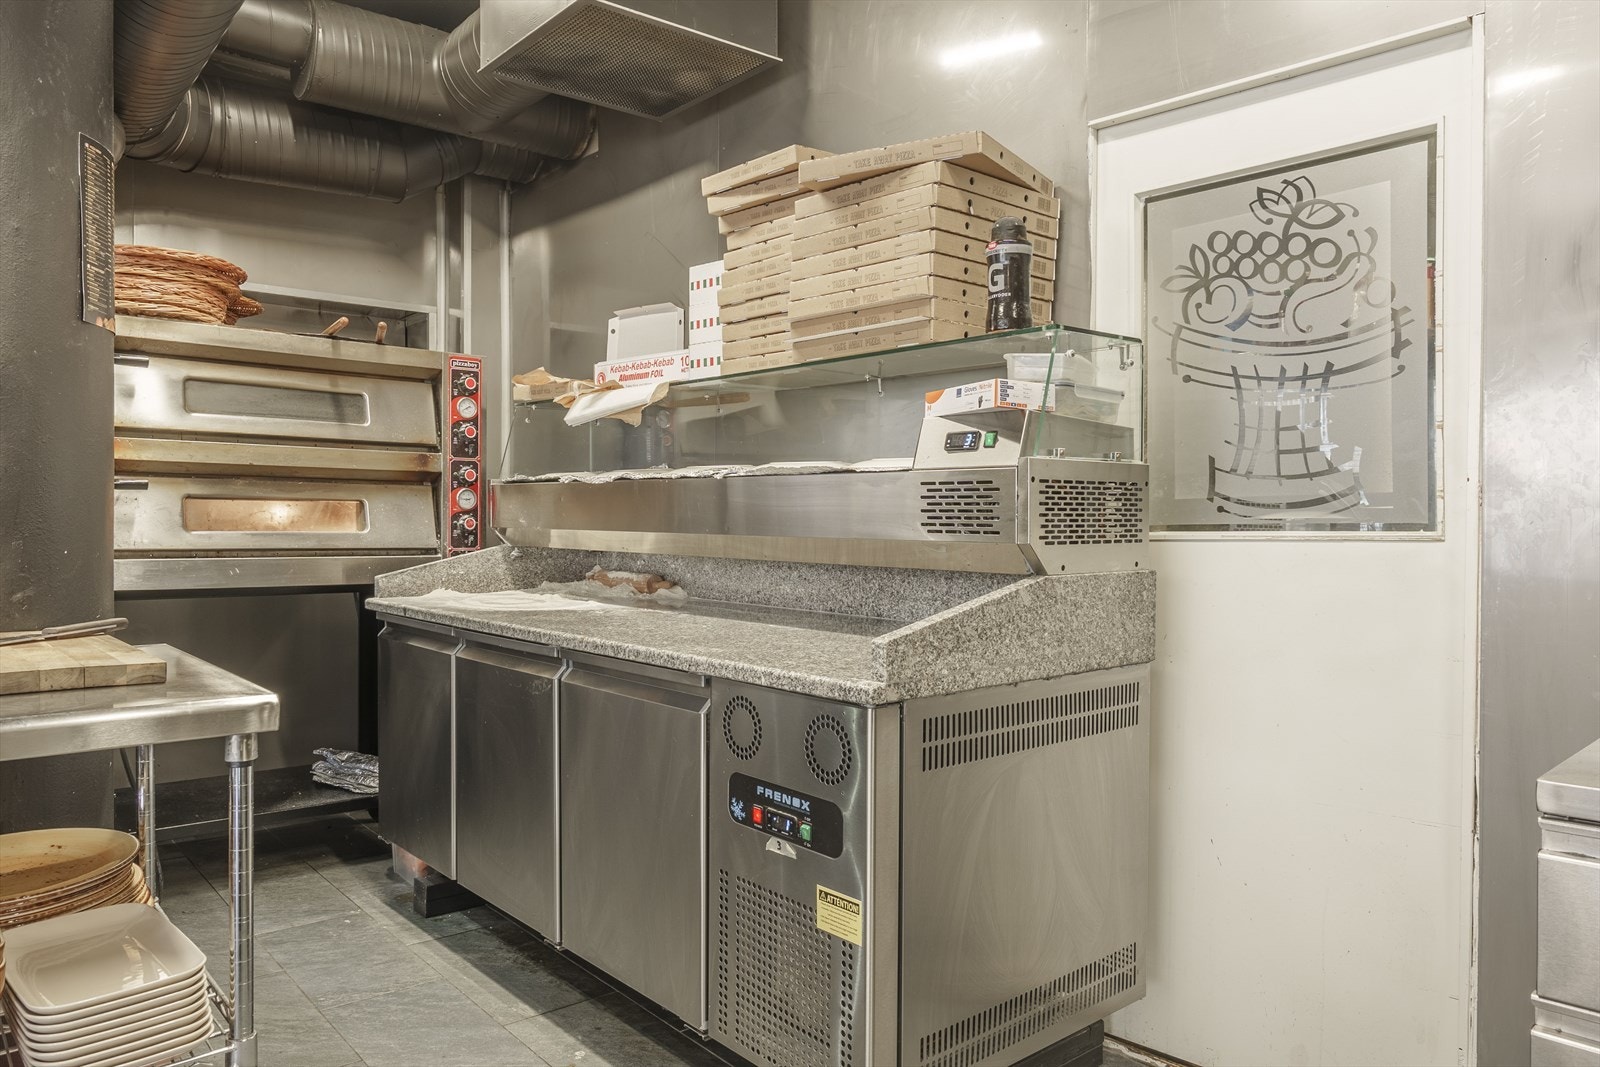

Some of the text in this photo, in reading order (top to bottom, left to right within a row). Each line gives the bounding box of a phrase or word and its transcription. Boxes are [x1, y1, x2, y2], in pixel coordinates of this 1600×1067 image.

[853, 150, 916, 169] TAKE AWAY PIZZA
[836, 183, 886, 204] TAKE AWAY PIZZA
[992, 184, 1008, 198] PIZZA
[834, 205, 884, 225] TAKE AWAY PIZZA
[832, 227, 881, 246] TAKE AWAY PIZZA
[832, 250, 881, 268] TAKE AWAY PIZZA
[864, 272, 880, 282] PIZZA
[988, 262, 1005, 293] G
[862, 293, 879, 304] PIZZA
[864, 315, 880, 325] PIZZA
[833, 337, 881, 352] TAKE AWAY PIZZA
[610, 357, 674, 374] Kebab-Kebab-Kebab
[618, 369, 664, 382] Aluminum FOIL
[964, 434, 972, 446] 3
[756, 785, 810, 812] FRENOX
[776, 840, 782, 850] 3
[826, 894, 859, 914] ATTENTION!
